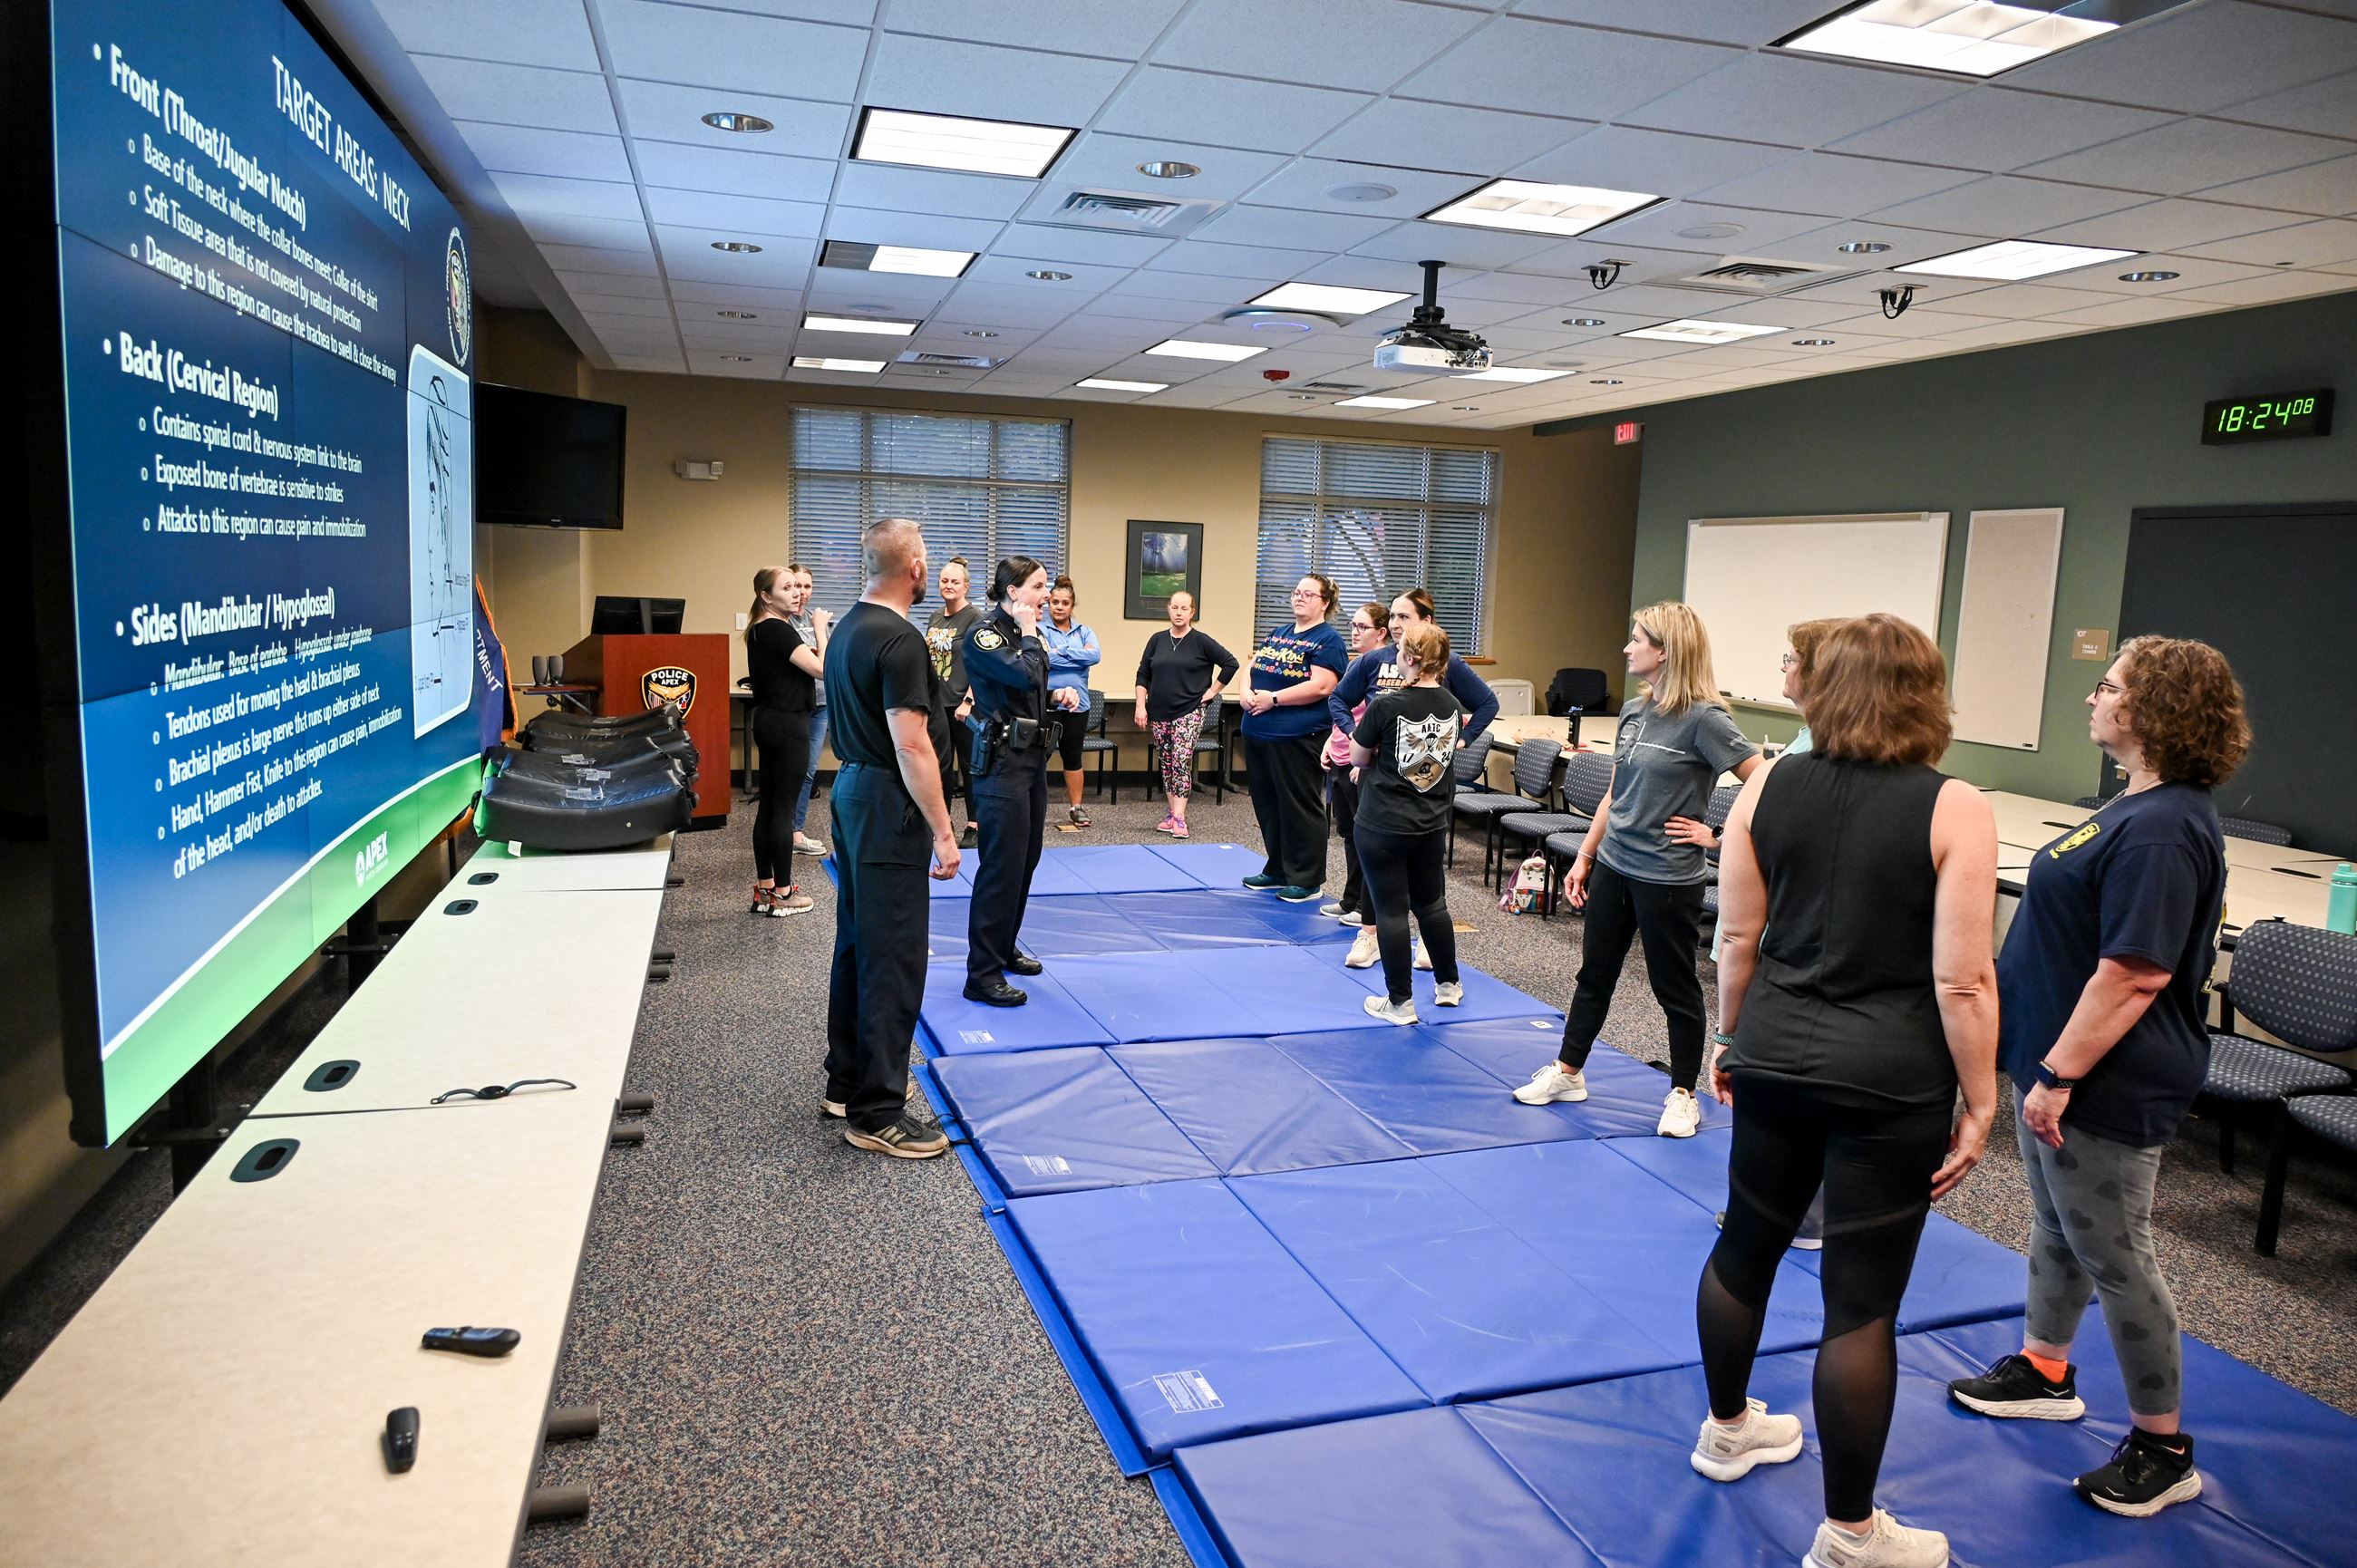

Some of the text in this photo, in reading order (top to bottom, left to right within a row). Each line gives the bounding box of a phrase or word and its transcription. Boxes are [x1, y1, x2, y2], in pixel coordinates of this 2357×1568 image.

[111, 44, 306, 231] Front (Throat/Jugular Notch)
[273, 55, 410, 232] TARGET AREAS: NECK
[144, 133, 170, 177] Base
[173, 158, 185, 186] of
[187, 165, 204, 198] the
[206, 184, 228, 215] neck
[229, 198, 256, 233] where
[257, 214, 271, 242] the
[272, 227, 292, 255] collar
[292, 236, 314, 269] bones
[333, 265, 350, 293] Collar
[351, 278, 357, 297] of
[357, 281, 366, 304] the
[367, 288, 378, 312] shirt
[145, 184, 362, 333] Soft Tissue area that is not covered by natural protection
[146, 235, 397, 387] Damage to this region can cause the trachea to swell & close the airway
[120, 331, 278, 421] Back (Cervical Region)
[2292, 398, 2314, 415] 08
[153, 406, 363, 473] Contains spinal cord & nervous system link to the brain
[1617, 423, 1634, 442] EXIT
[155, 453, 344, 502] Exposed bone of vertebrae is sensitive to strikes
[158, 503, 366, 541] Attacks to this region can cause pain and immobilization
[131, 586, 335, 646] Sides (Mandibular / Hypoglossal)
[164, 624, 373, 692] Mandibular: Base of earlobe Hypoglossal: under jawbone
[651, 670, 689, 682] POLICE
[1378, 663, 1404, 680] AS
[166, 660, 361, 740] Tendons used for moving the head & brachial plexus
[169, 682, 380, 787] Brachial plexus is large nerve that runs up either side of neck
[1402, 753, 1414, 763] 17
[171, 705, 403, 833] Hand, Hammer Fist, Knife to this region can cause pain, immobilization
[174, 778, 323, 879] of the head, and/or death to attacker.
[365, 830, 388, 872] APEX
